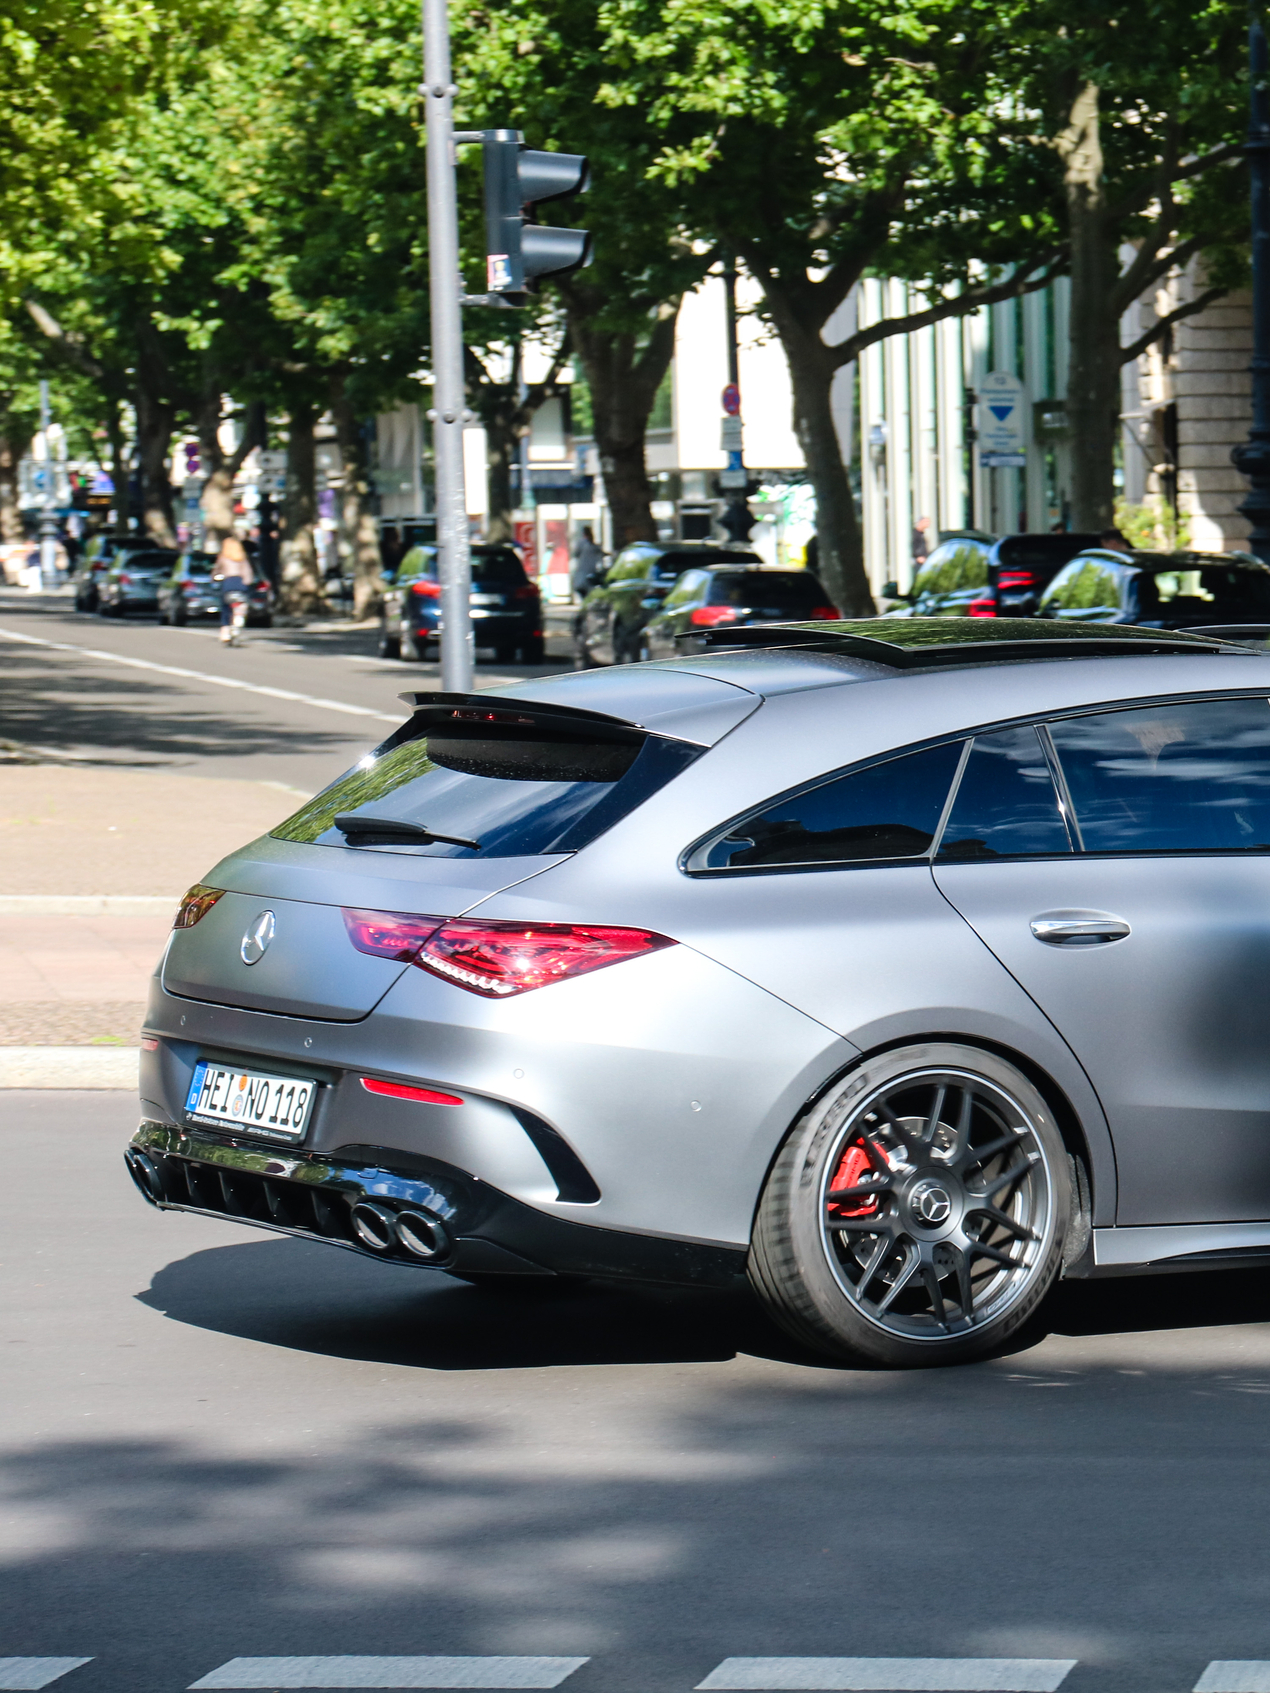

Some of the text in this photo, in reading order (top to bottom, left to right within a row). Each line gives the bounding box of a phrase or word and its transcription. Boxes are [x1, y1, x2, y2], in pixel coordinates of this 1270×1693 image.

[198, 1069, 308, 1128] HEI NO 118
